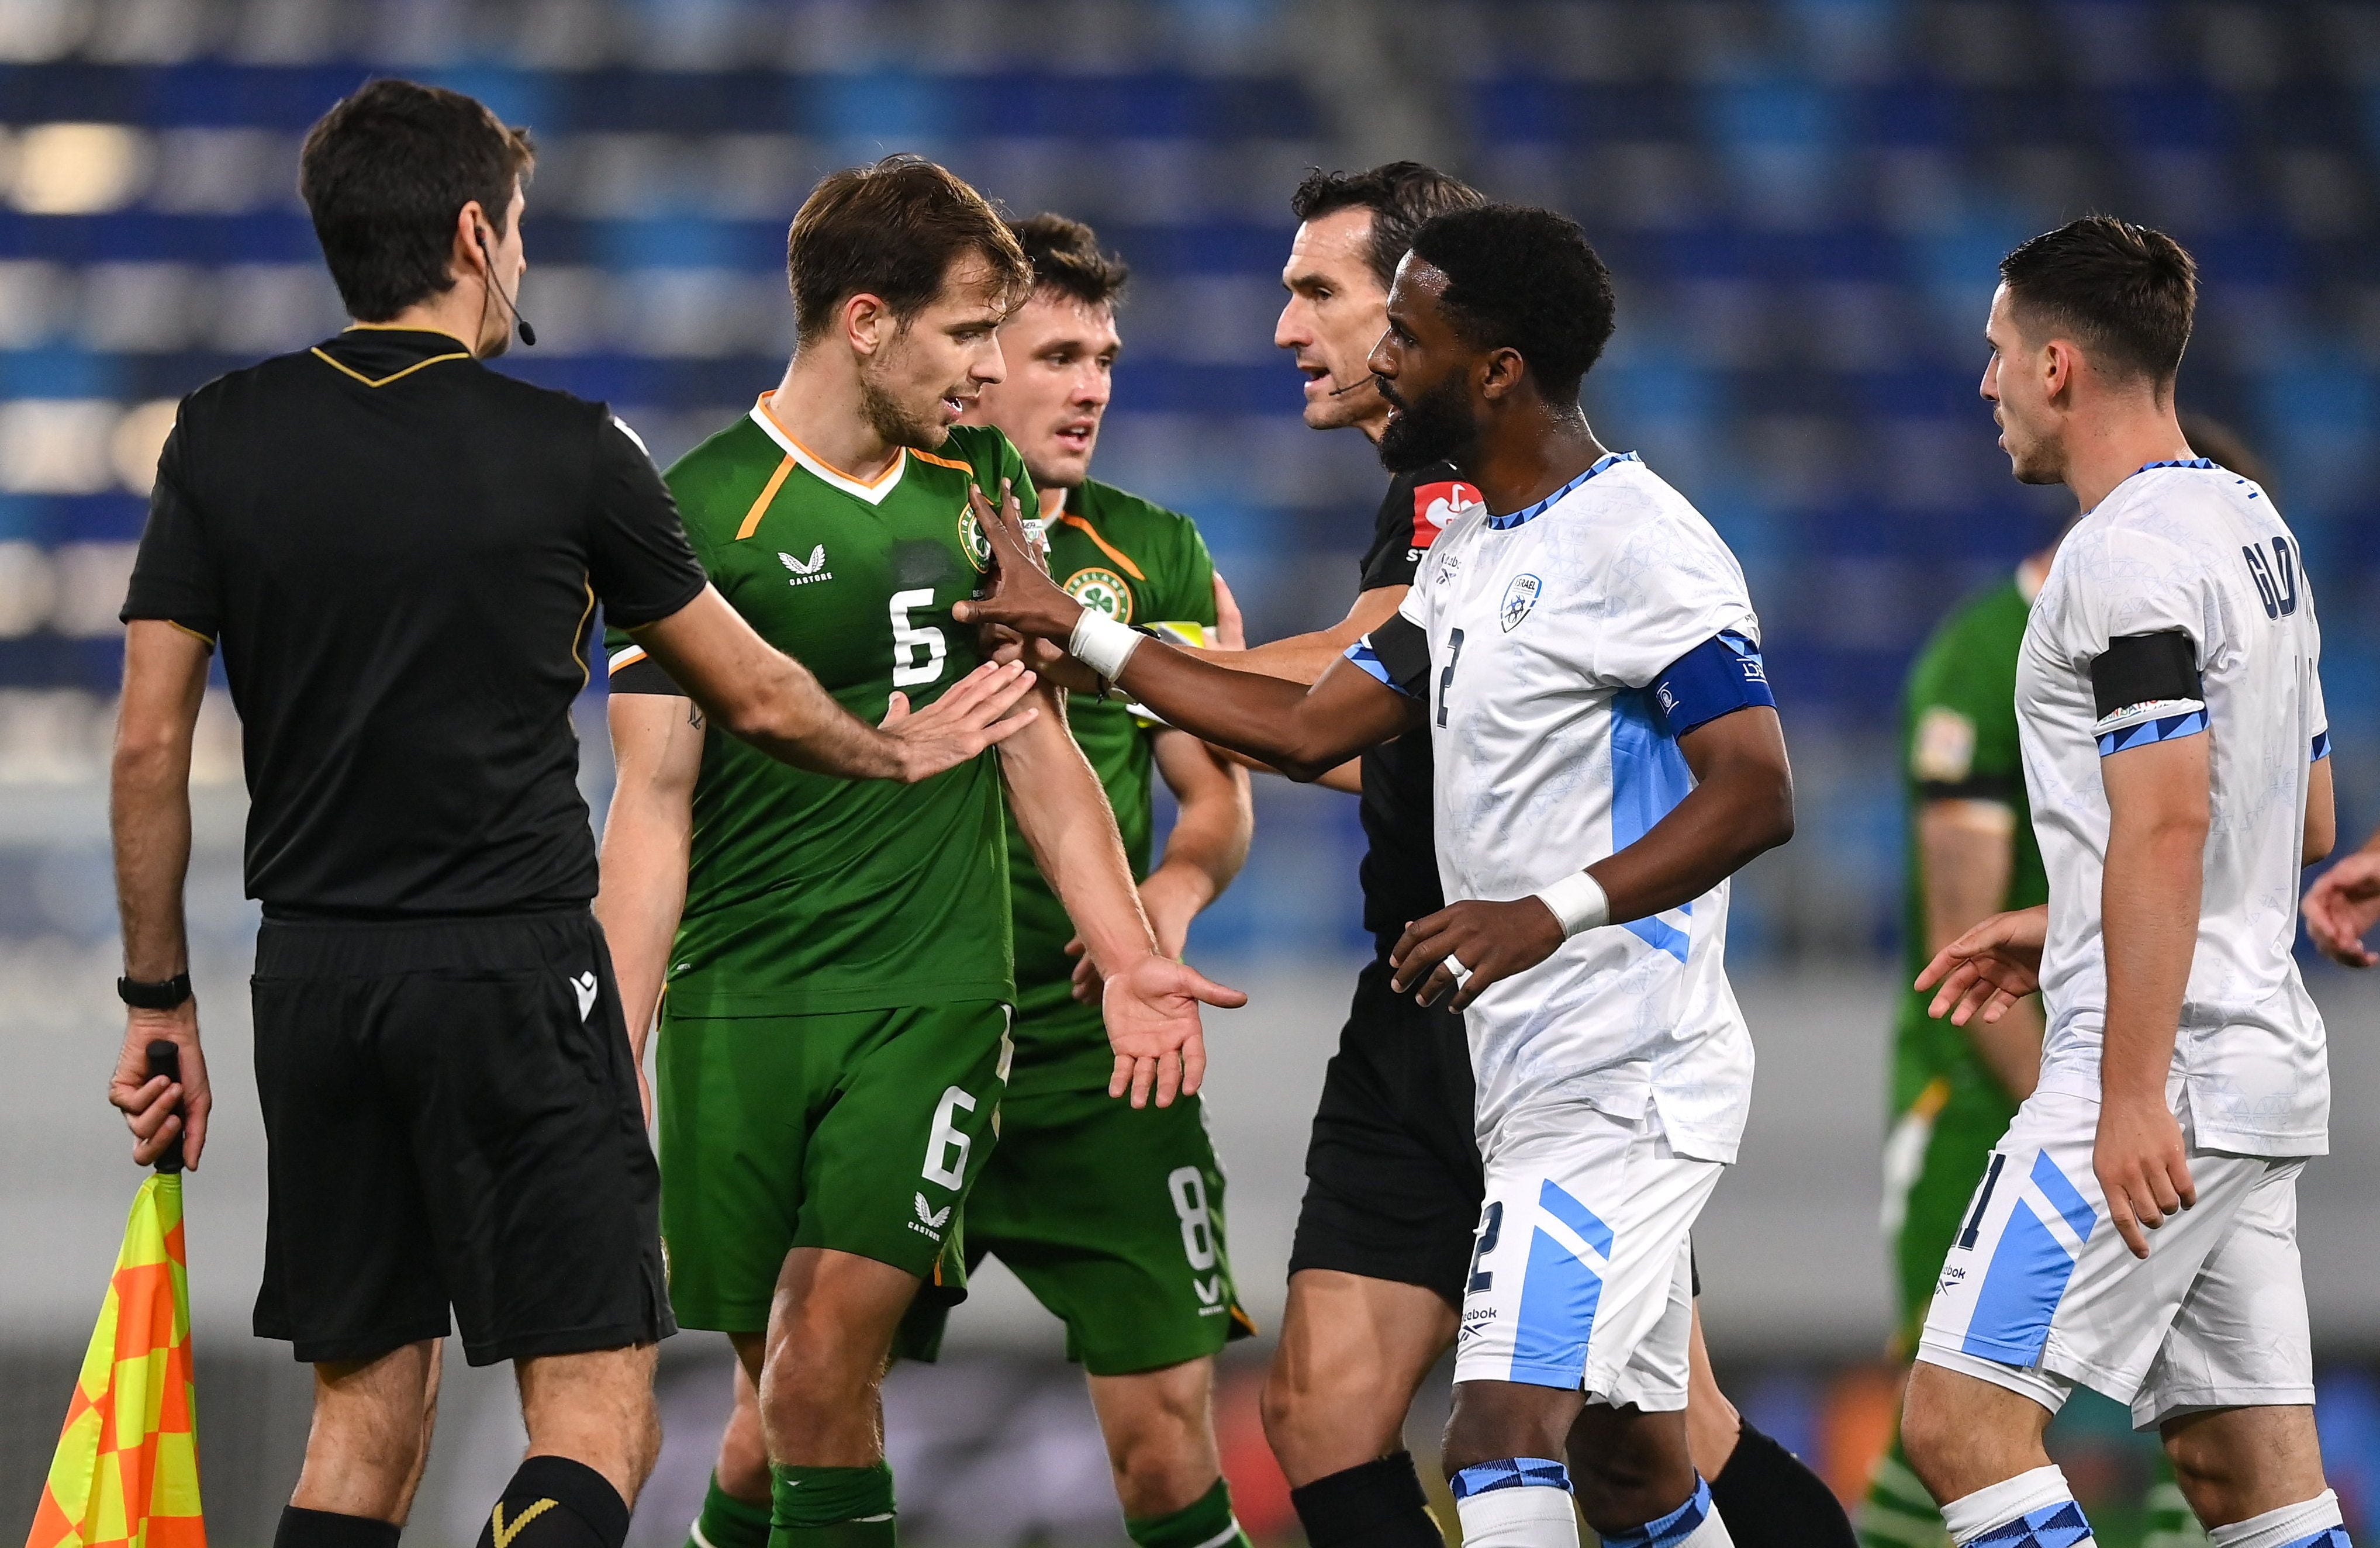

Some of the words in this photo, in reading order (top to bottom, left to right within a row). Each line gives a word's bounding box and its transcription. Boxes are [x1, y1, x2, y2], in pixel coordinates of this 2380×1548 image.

[789, 572, 833, 586] CASTORE
[1514, 578, 1535, 590] ISRAEL
[2242, 535, 2303, 621] GLO
[889, 588, 947, 687] 6
[1436, 627, 1464, 729] 2
[921, 1086, 976, 1191] 6
[1168, 1166, 1215, 1271] 8
[1467, 1201, 1503, 1297] 2
[1463, 1307, 1497, 1322] eebok
